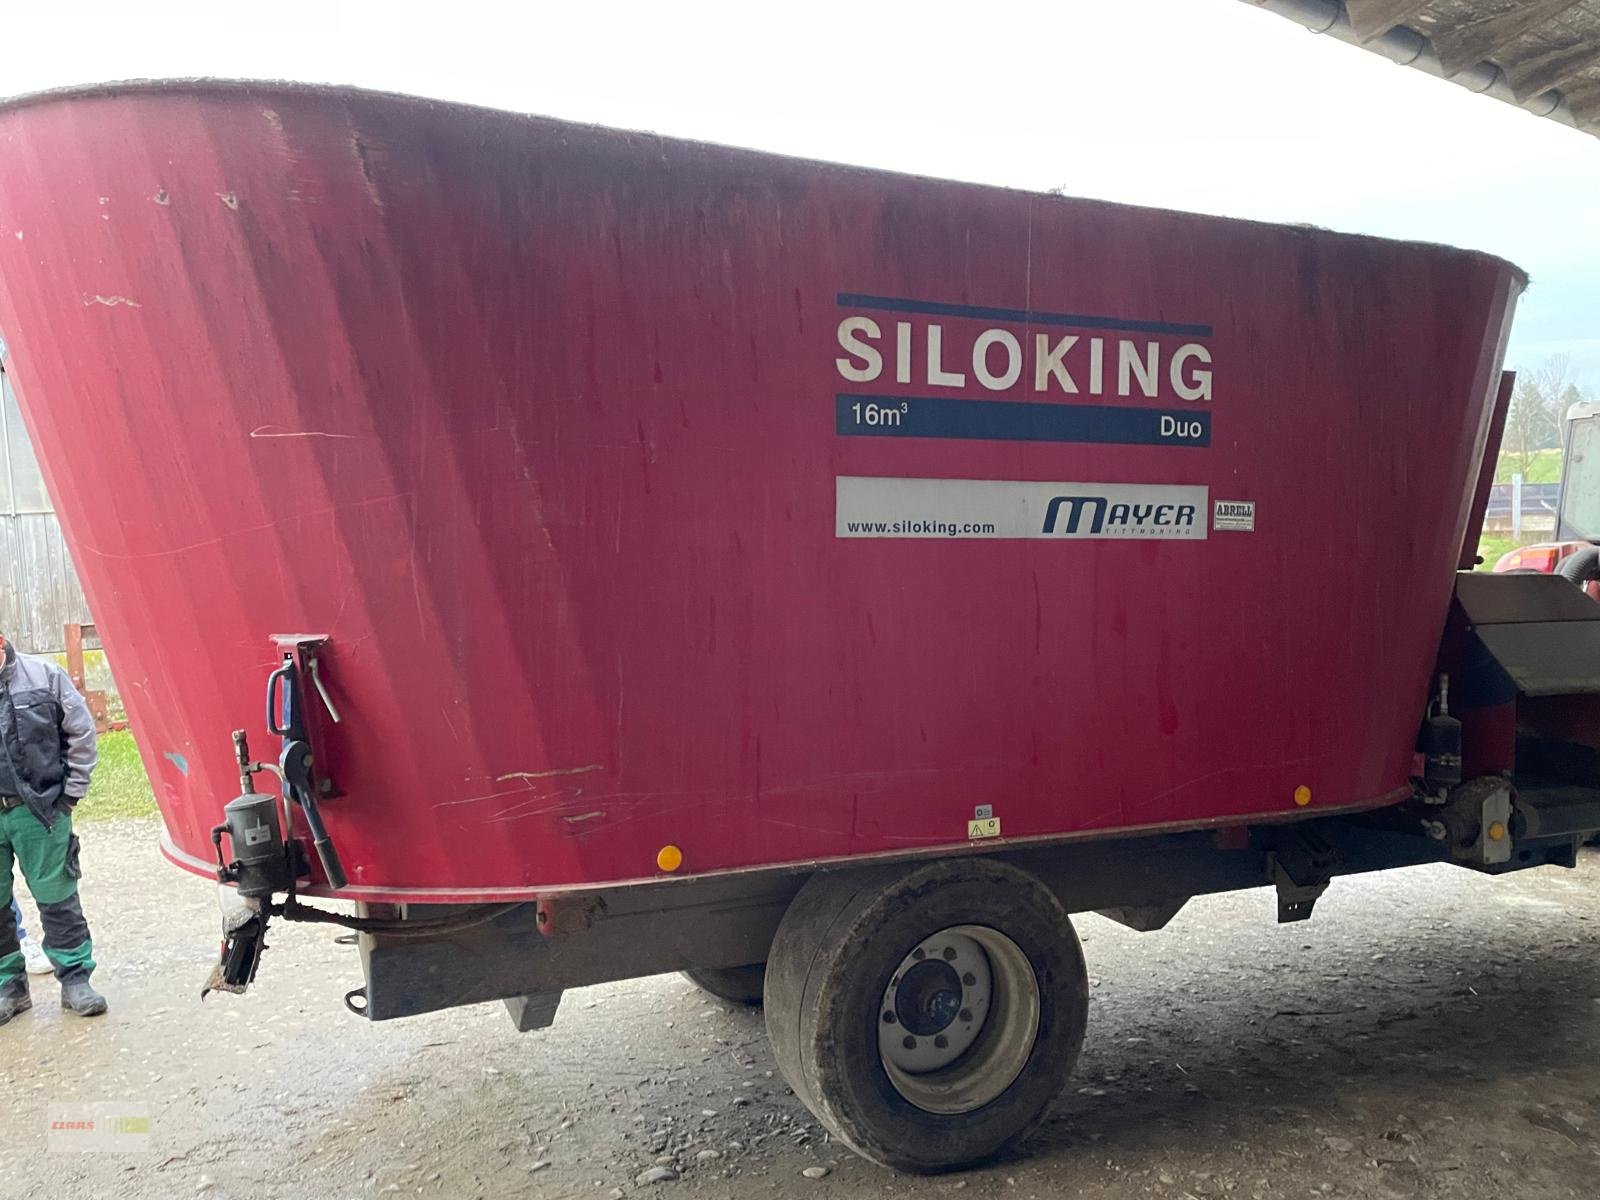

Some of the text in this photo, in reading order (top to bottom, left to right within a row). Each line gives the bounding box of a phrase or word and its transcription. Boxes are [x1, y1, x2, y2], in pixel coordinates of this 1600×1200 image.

[835, 315, 1213, 401] SILOKING
[1160, 416, 1202, 438] Duo
[1042, 496, 1195, 534] MAYER
[1216, 504, 1252, 517] ABRELL
[848, 520, 995, 536] www.siloking.com
